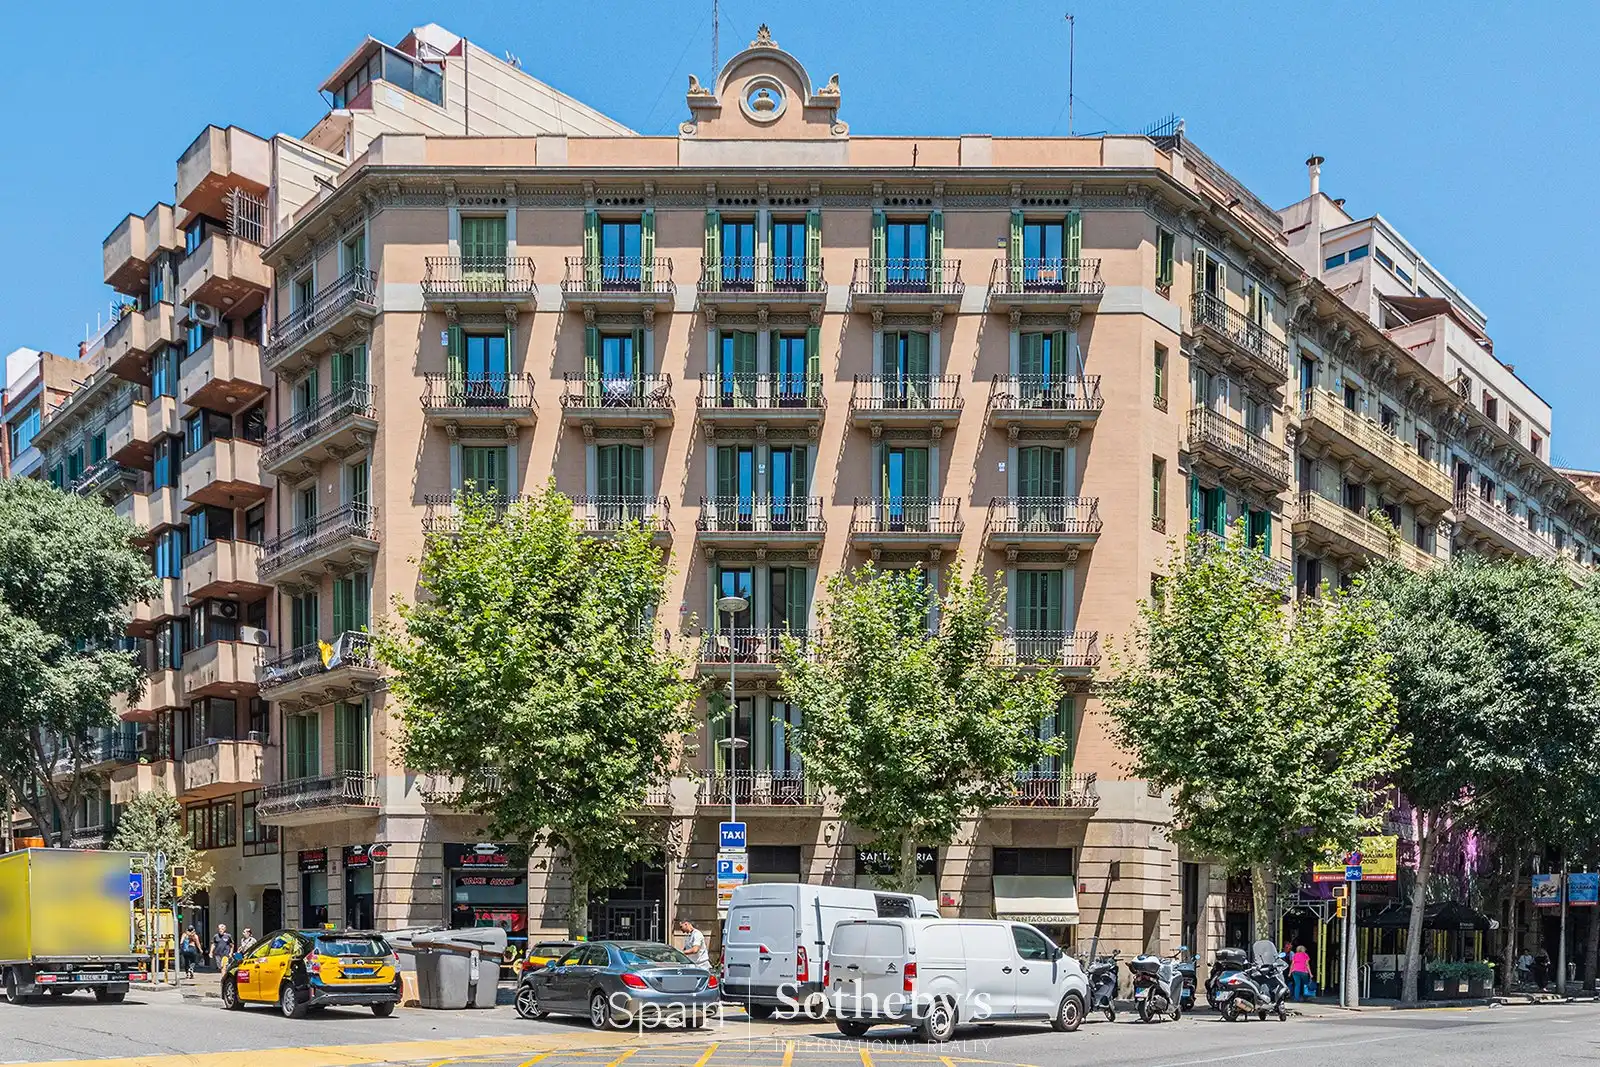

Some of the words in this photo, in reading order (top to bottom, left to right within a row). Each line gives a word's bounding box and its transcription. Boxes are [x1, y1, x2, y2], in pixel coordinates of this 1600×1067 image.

[722, 831, 744, 839] TAXI
[460, 855, 475, 863] LA
[721, 862, 729, 872] P
[462, 877, 486, 885] TAKE
[490, 877, 516, 886] AWAY
